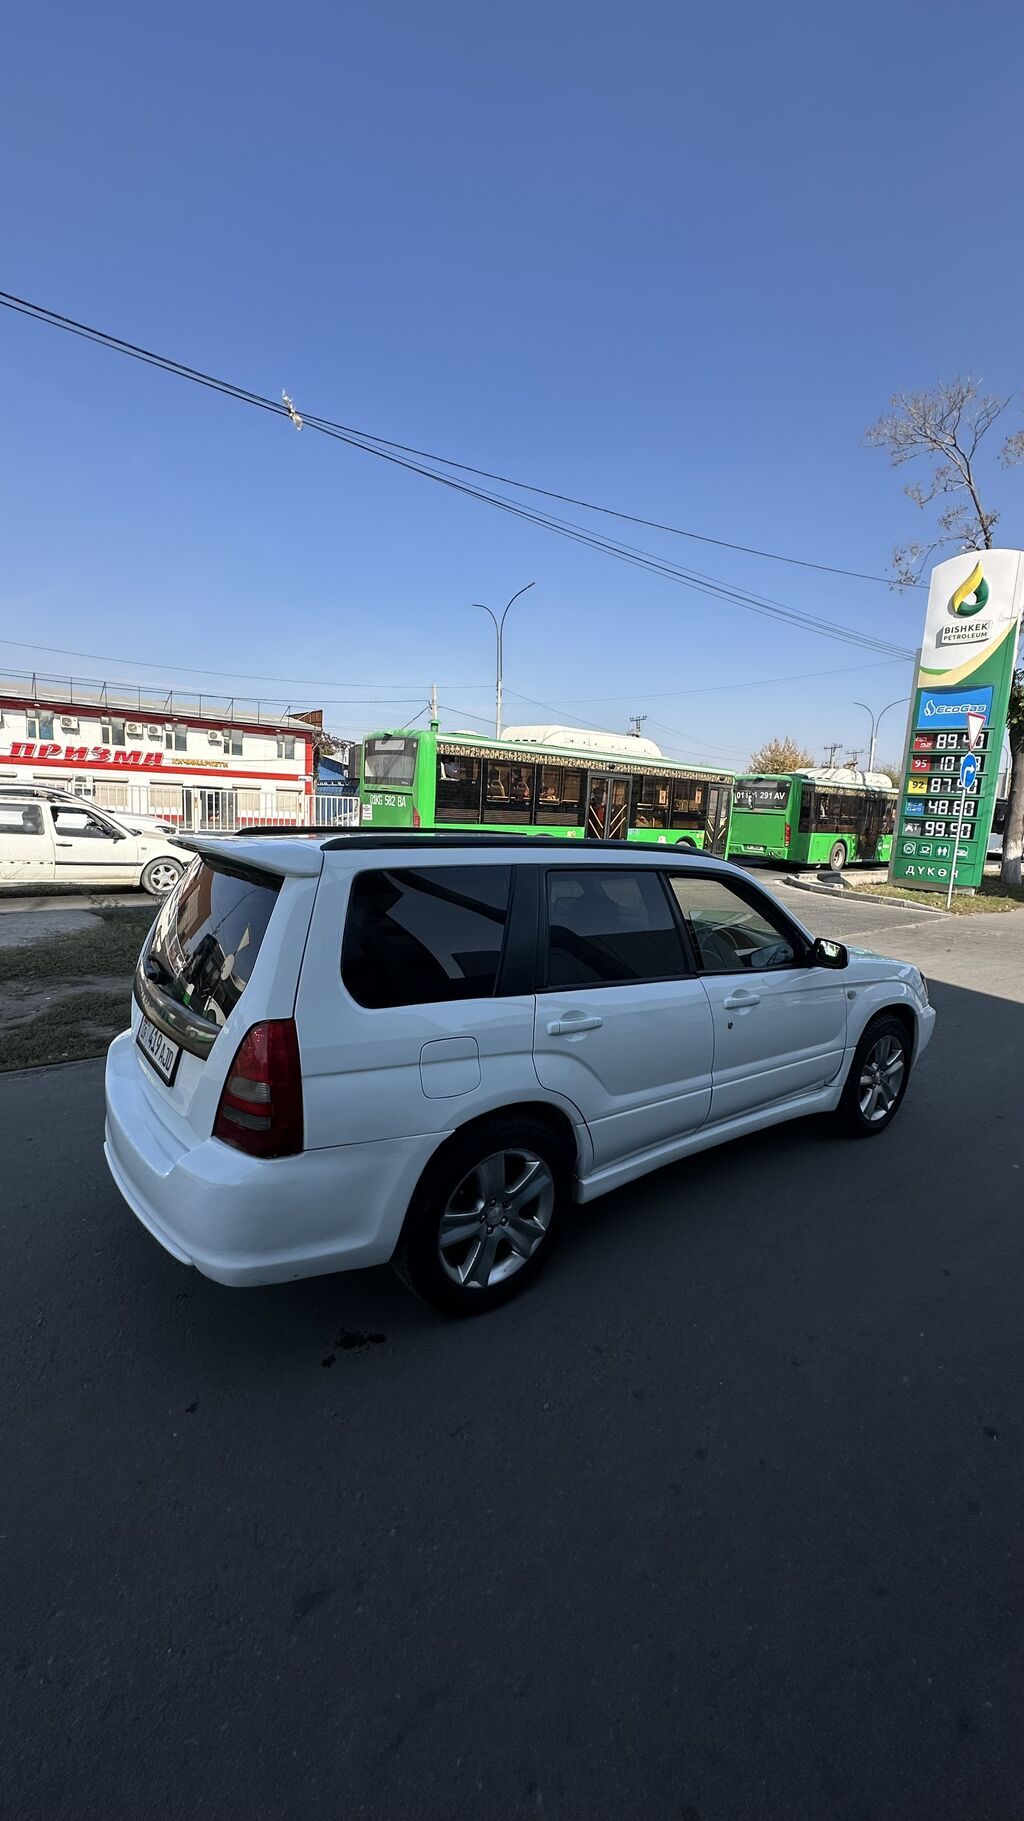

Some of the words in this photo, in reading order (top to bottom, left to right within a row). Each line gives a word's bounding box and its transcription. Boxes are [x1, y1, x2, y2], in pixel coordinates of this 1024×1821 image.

[944, 622, 989, 634] BISHKEK
[943, 632, 987, 641] PETROLEUM
[9, 741, 164, 767] ПРИЗМА
[915, 759, 927, 768] 95
[912, 780, 925, 789] 92
[759, 791, 773, 800] 291
[773, 792, 786, 800] AV
[397, 796, 407, 808] BA
[148, 1027, 162, 1056] 419
